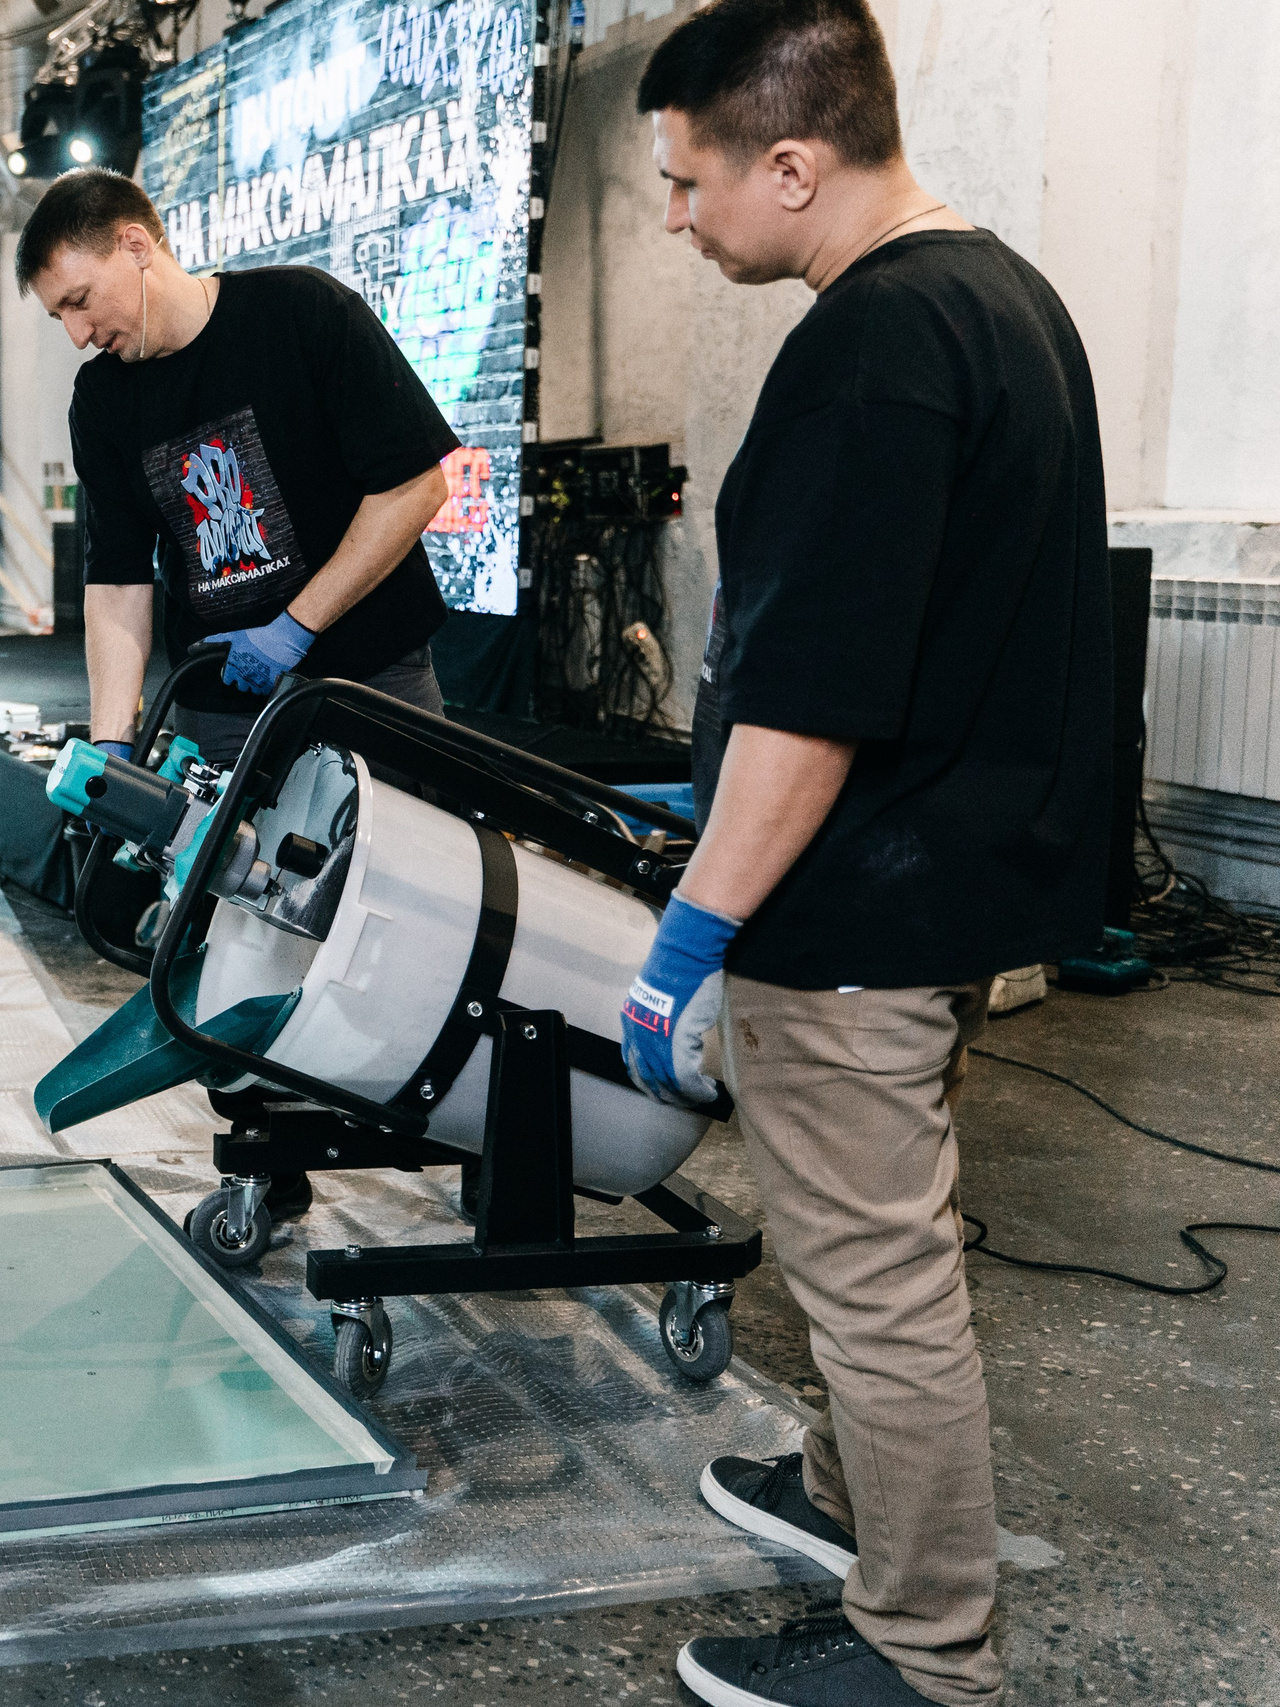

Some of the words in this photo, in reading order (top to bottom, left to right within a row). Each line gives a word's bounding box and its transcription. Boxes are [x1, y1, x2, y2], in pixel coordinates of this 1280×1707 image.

[168, 201, 206, 270] НА
[197, 581, 211, 593] НА
[211, 556, 291, 589] МАКСИМАЛКАХ
